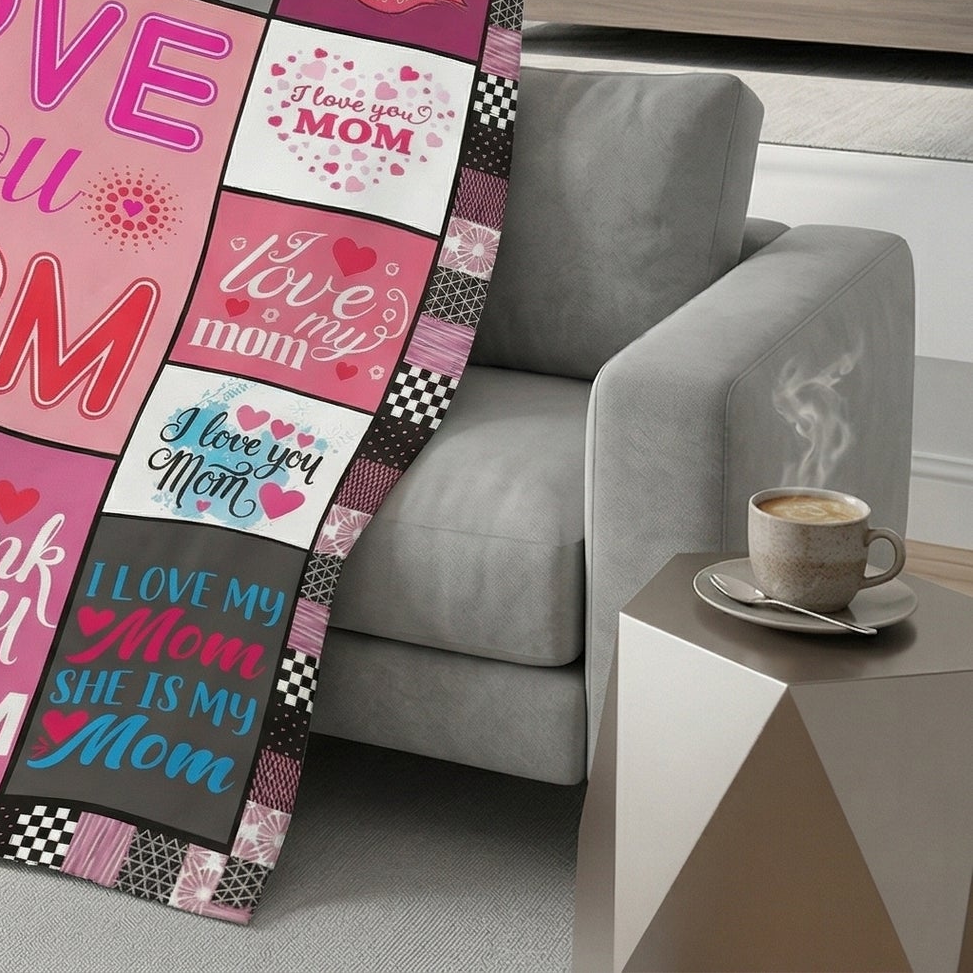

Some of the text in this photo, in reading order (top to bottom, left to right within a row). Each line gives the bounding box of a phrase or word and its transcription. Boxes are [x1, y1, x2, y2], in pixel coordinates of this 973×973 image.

[291, 85, 432, 125] I love you
[293, 108, 415, 155] MOM
[219, 234, 377, 320] love
[188, 317, 308, 371] mom
[294, 288, 409, 362] my
[160, 407, 324, 485] I love you
[148, 447, 257, 518] Mom
[86, 561, 105, 597] I
[111, 565, 218, 609] LOVE
[65, 606, 266, 680] Mom
[49, 669, 134, 706] SHE
[137, 672, 184, 713] IS
[27, 713, 235, 794] Mom
